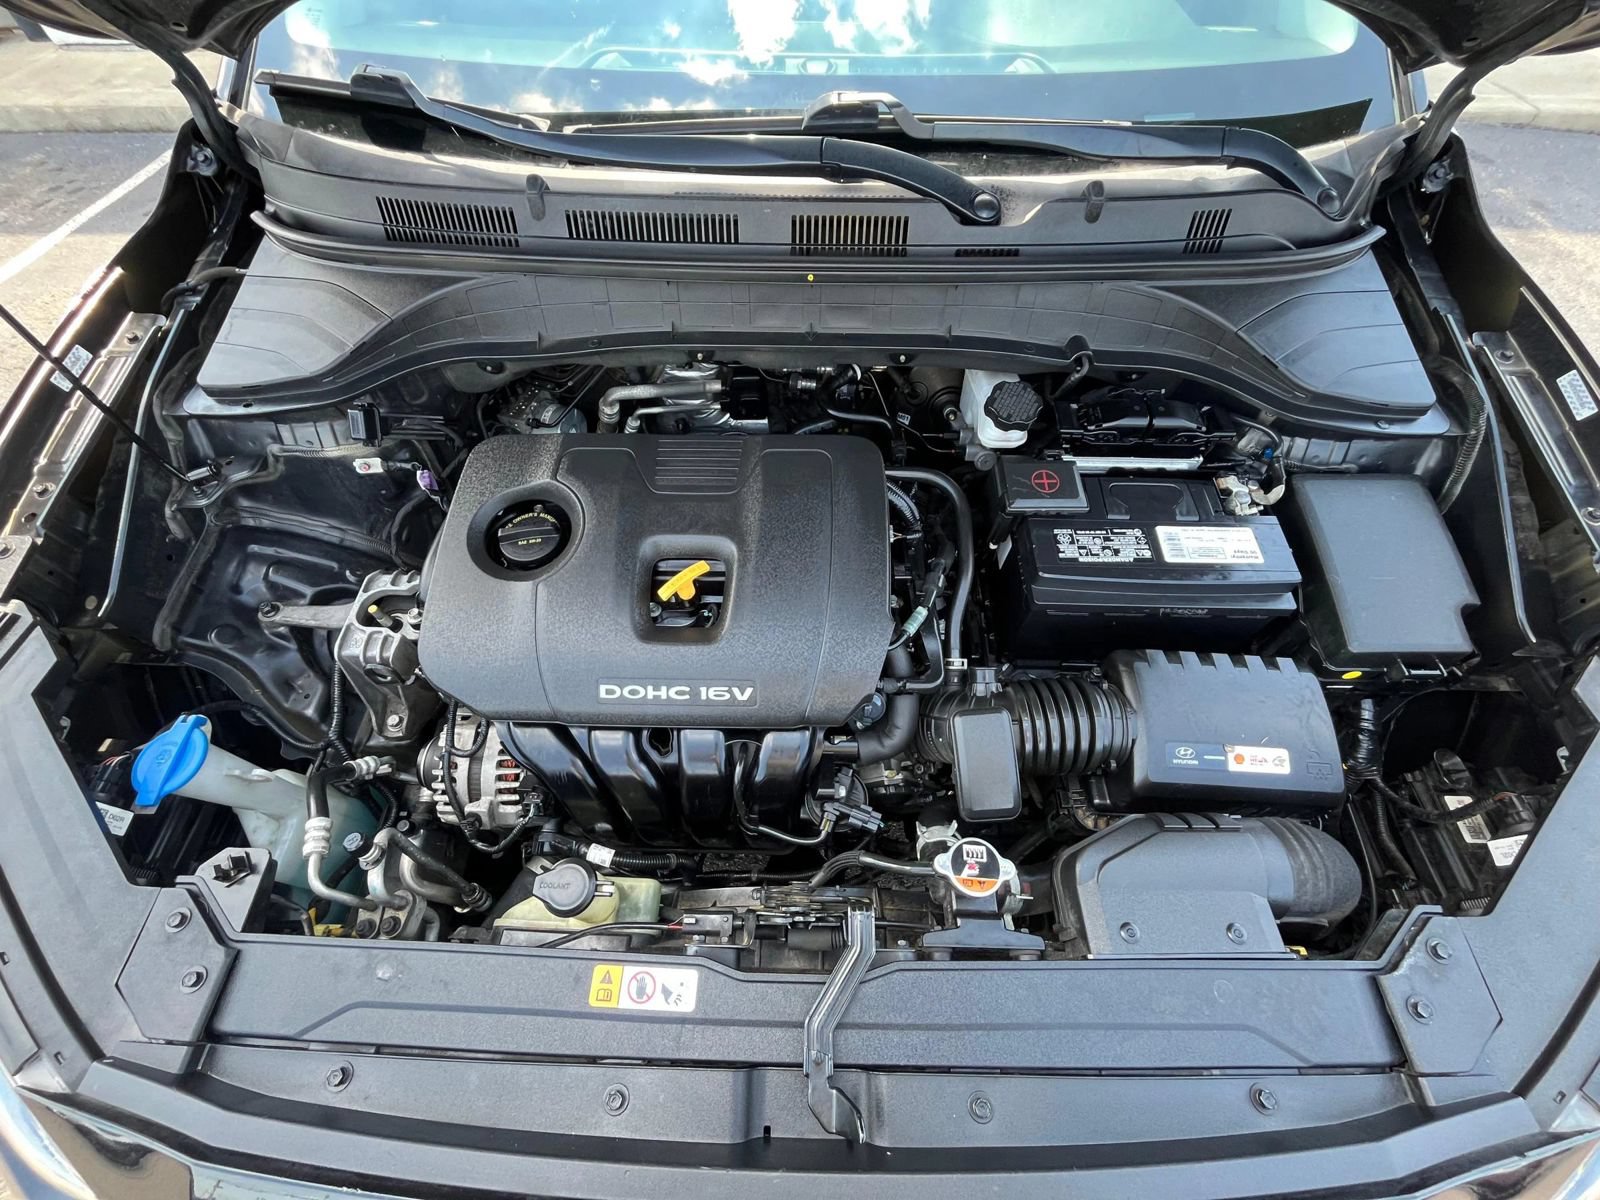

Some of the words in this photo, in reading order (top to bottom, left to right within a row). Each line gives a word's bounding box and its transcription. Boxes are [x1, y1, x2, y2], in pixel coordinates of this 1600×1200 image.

[599, 684, 691, 700] DOHC
[700, 686, 754, 701] 16V
[1172, 758, 1199, 766] HYUNDAI
[538, 880, 571, 890] COOLANT
